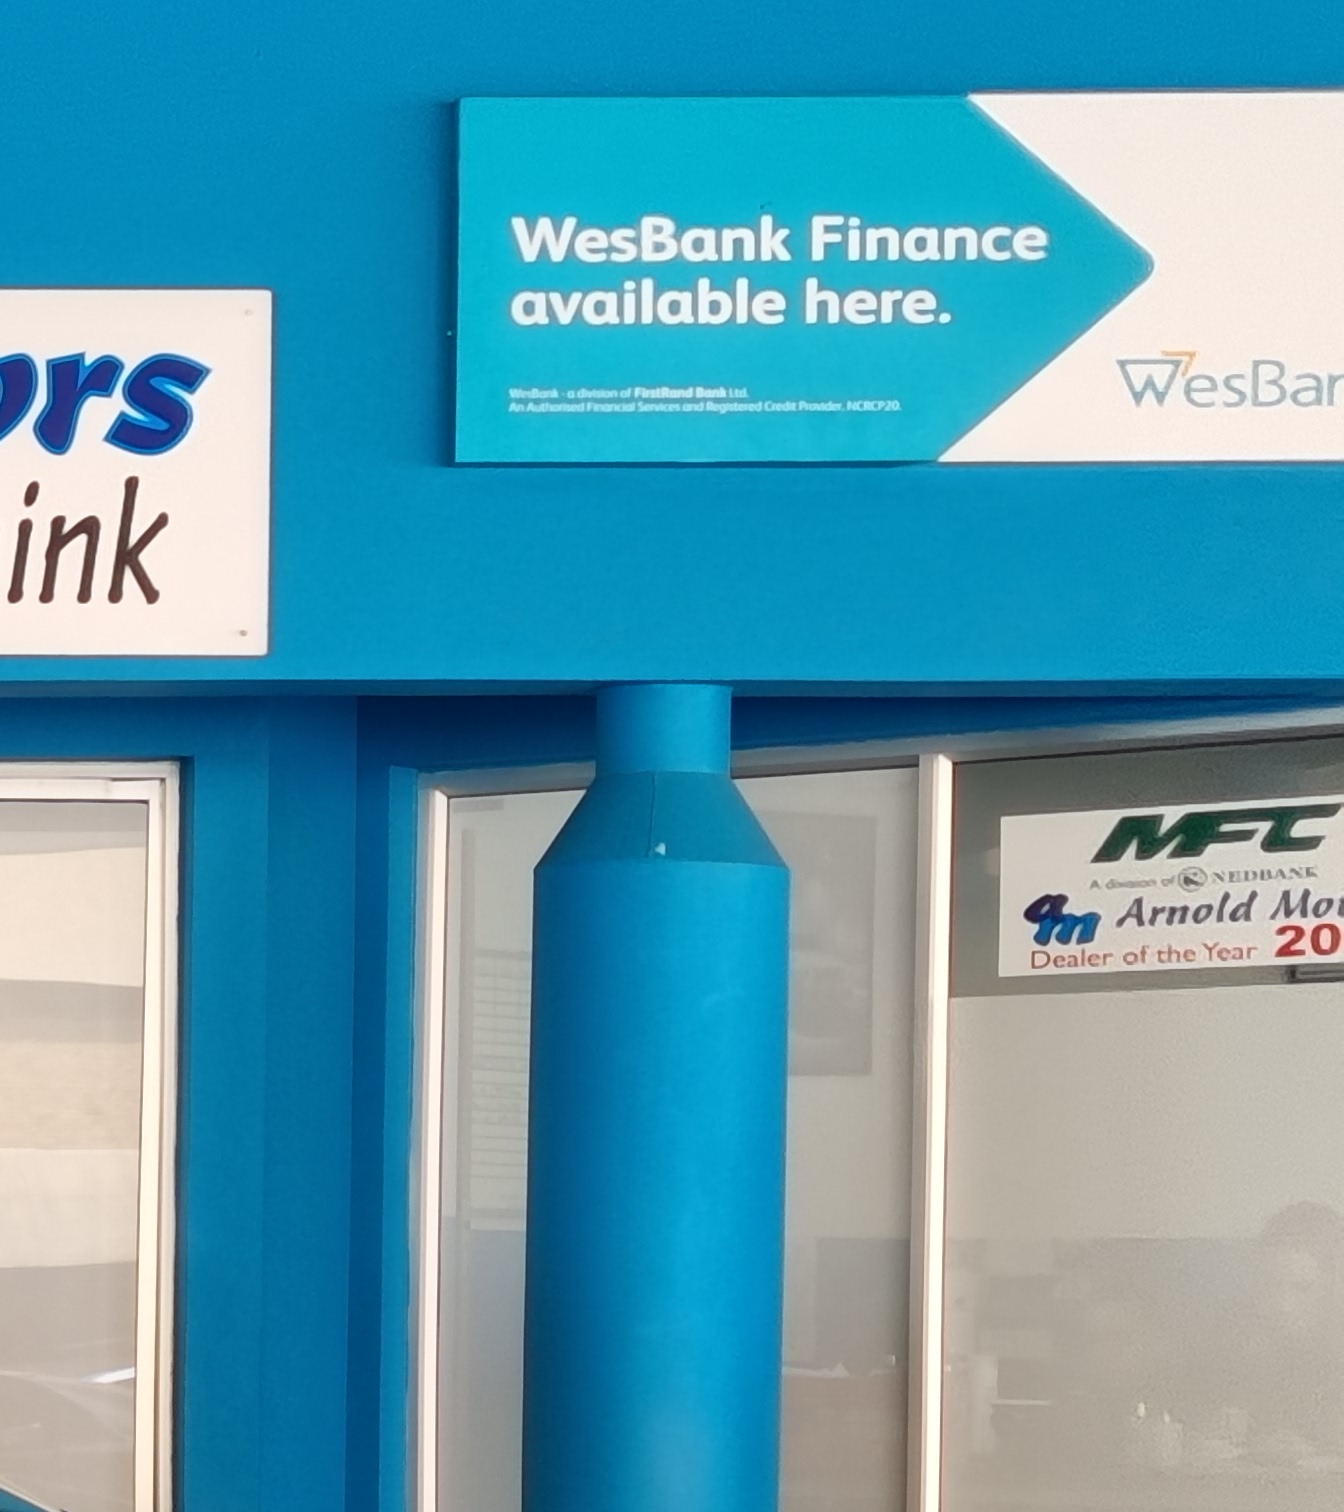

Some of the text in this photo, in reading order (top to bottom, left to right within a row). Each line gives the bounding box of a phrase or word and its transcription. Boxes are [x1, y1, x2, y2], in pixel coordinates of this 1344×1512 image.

[510, 214, 1047, 262] WesBank Finance
[510, 278, 952, 326] available here.
[509, 388, 559, 399] WesBank
[577, 388, 617, 399] division
[620, 388, 631, 399] of
[634, 386, 693, 399] FirstRand
[695, 386, 727, 399] Bank
[728, 387, 749, 399] Ltd.
[509, 402, 524, 412] An
[587, 402, 636, 412] Financial
[637, 402, 680, 412] Services
[682, 402, 703, 412] and
[706, 401, 763, 415] Registered
[764, 401, 797, 412] Credit
[1090, 804, 1342, 863] MFC
[1213, 866, 1318, 884] NEDBANK
[1116, 890, 1258, 928] Arnold
[1031, 949, 1113, 970] Dealer
[1123, 945, 1148, 966] of
[1156, 944, 1196, 964] the
[1201, 941, 1258, 962] Year
